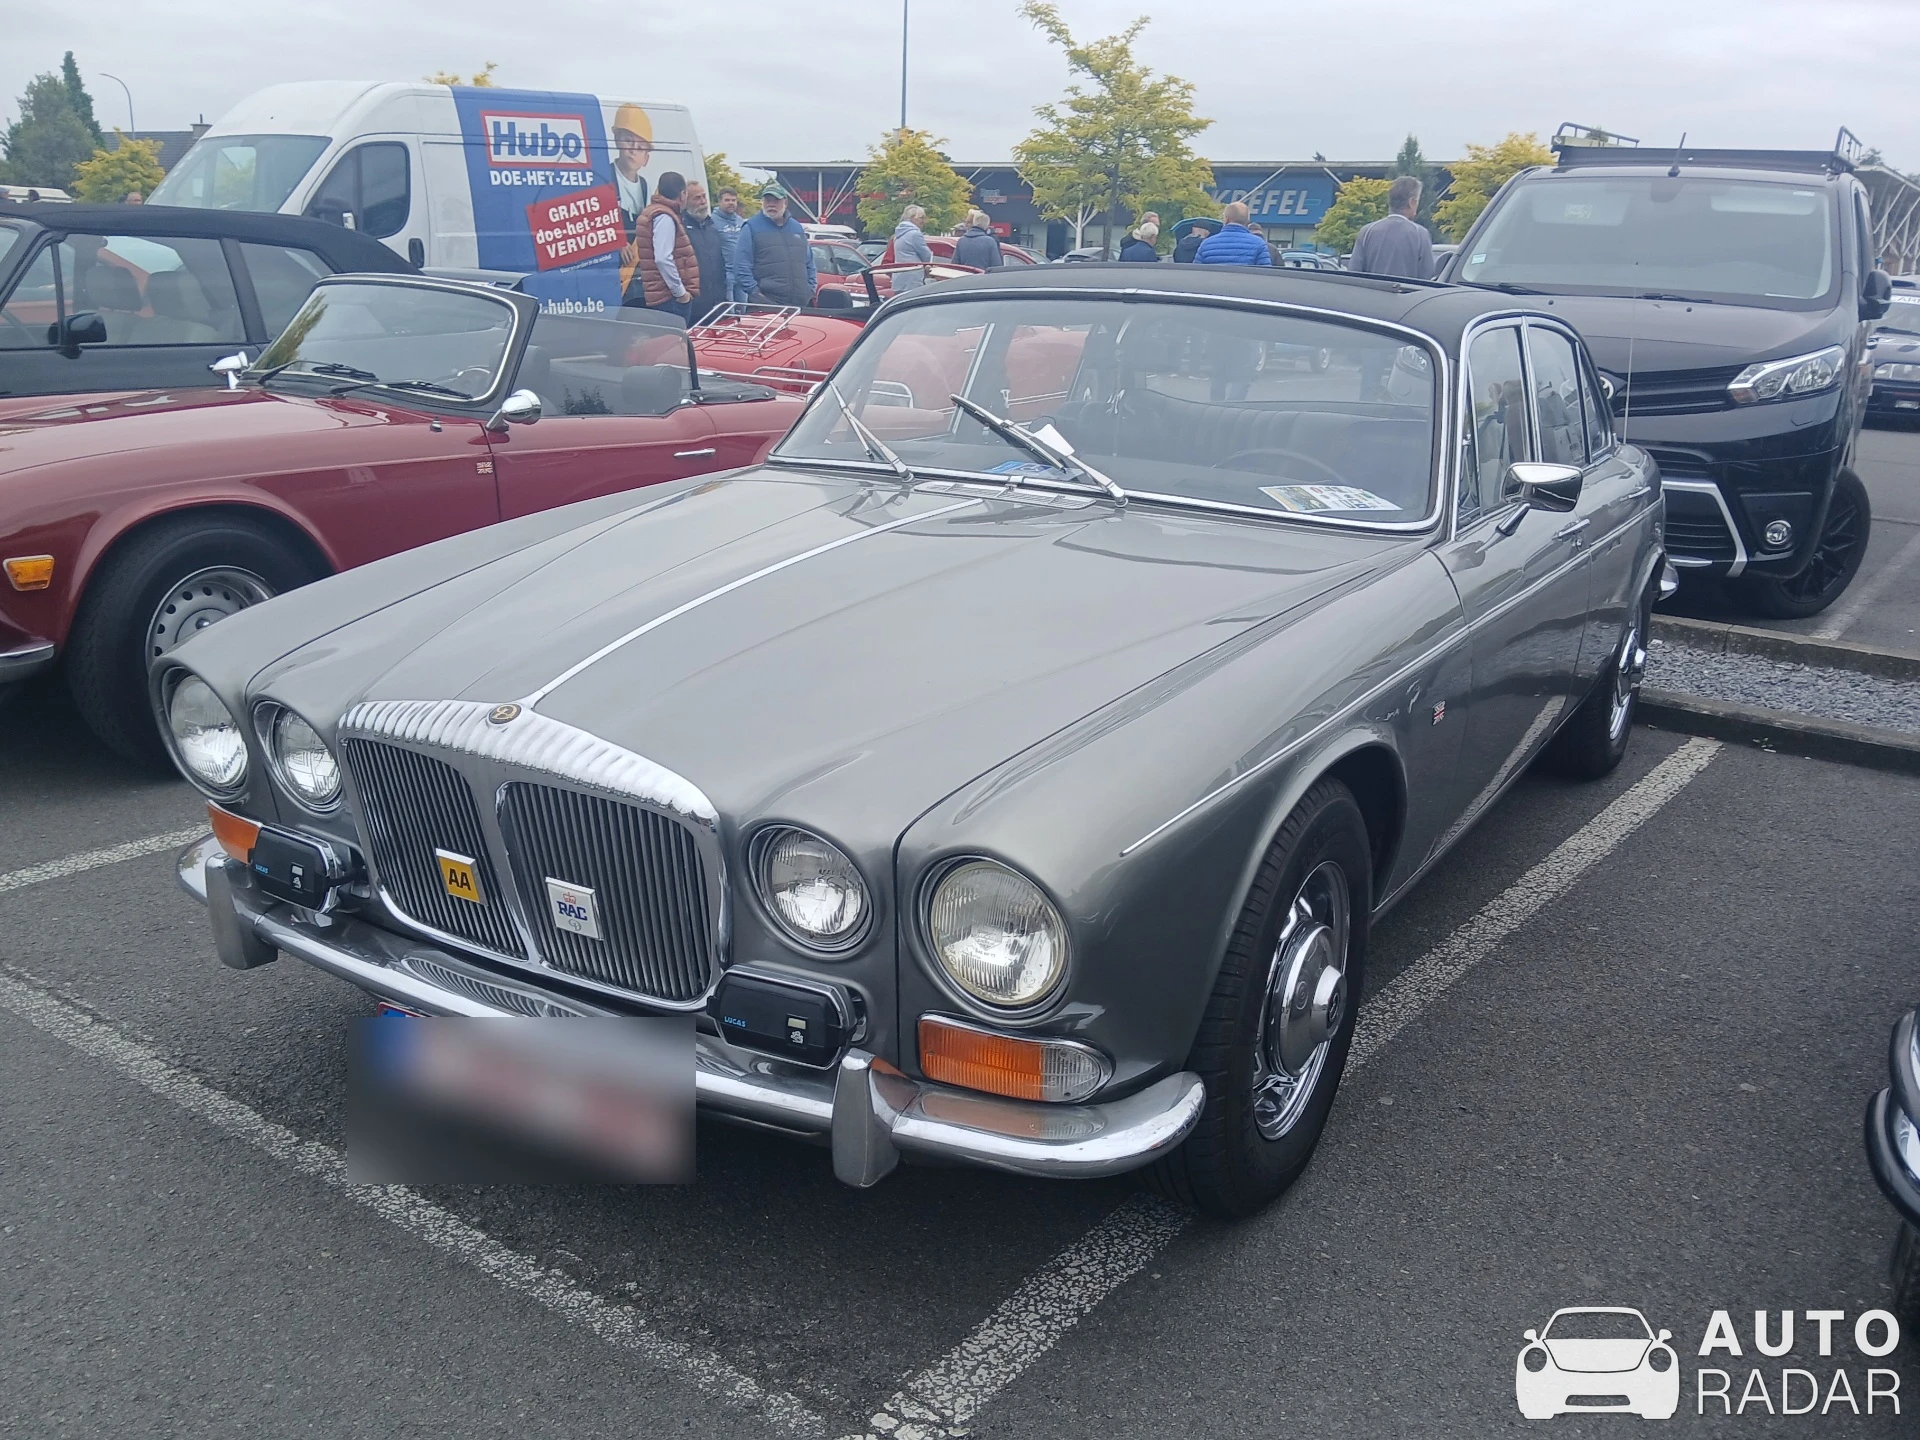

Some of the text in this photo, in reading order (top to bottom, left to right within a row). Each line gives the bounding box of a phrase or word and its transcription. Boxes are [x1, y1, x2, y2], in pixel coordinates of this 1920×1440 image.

[493, 121, 582, 158] Hubo
[490, 170, 594, 186] DOE-HET-ZELF
[548, 197, 600, 223] GRATIS
[536, 208, 619, 244] doe-het-zelf
[546, 227, 617, 259] VERVOER
[448, 868, 472, 891] AA
[556, 901, 588, 921] RAC
[724, 1015, 747, 1028] LUCAS
